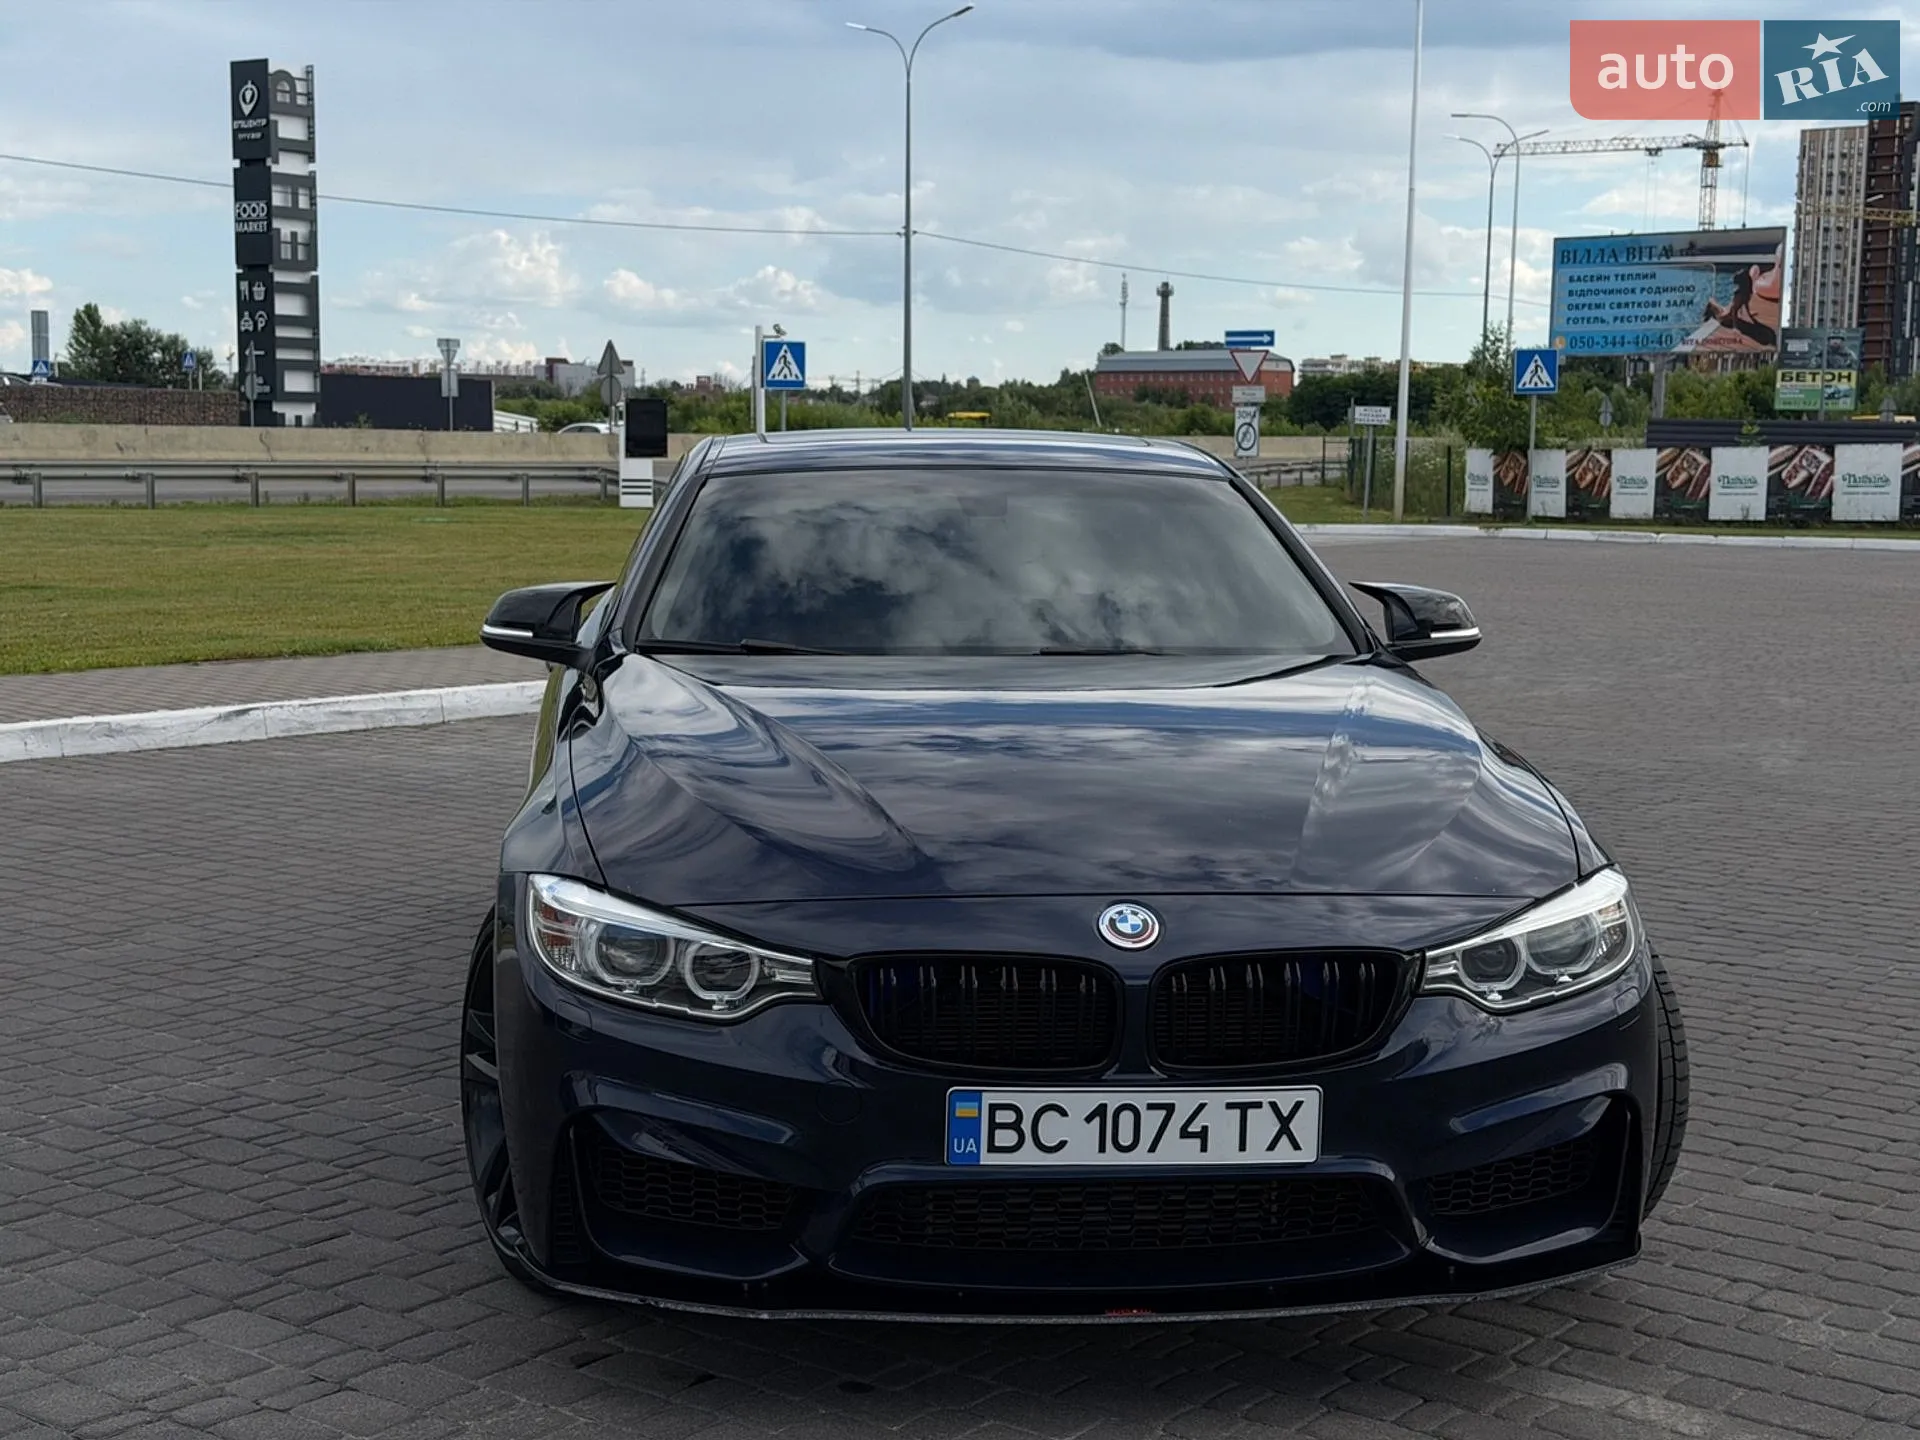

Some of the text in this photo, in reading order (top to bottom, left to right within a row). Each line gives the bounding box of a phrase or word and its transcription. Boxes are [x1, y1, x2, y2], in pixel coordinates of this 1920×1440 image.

[235, 202, 268, 218] FOOD
[235, 221, 268, 232] MARKET
[1560, 244, 1672, 264] ВІЛЛА ВІТА
[1568, 271, 1656, 283] БАСЕЙН ТЕПЛИЙ
[1568, 284, 1696, 298] ВІДПОЧИНОК РОДИНОЮ
[1567, 299, 1694, 311] ОКРЕМІ СВЯТКОВІ ЗАЛИ
[1566, 313, 1669, 326] ГОТЕЛЬ, РЕСТОРАН
[1569, 334, 1673, 349] 050-344-40-40
[1781, 371, 1852, 382] БЕТОН
[986, 1100, 1305, 1154] BC 1074 TX
[954, 1138, 977, 1153] UA
